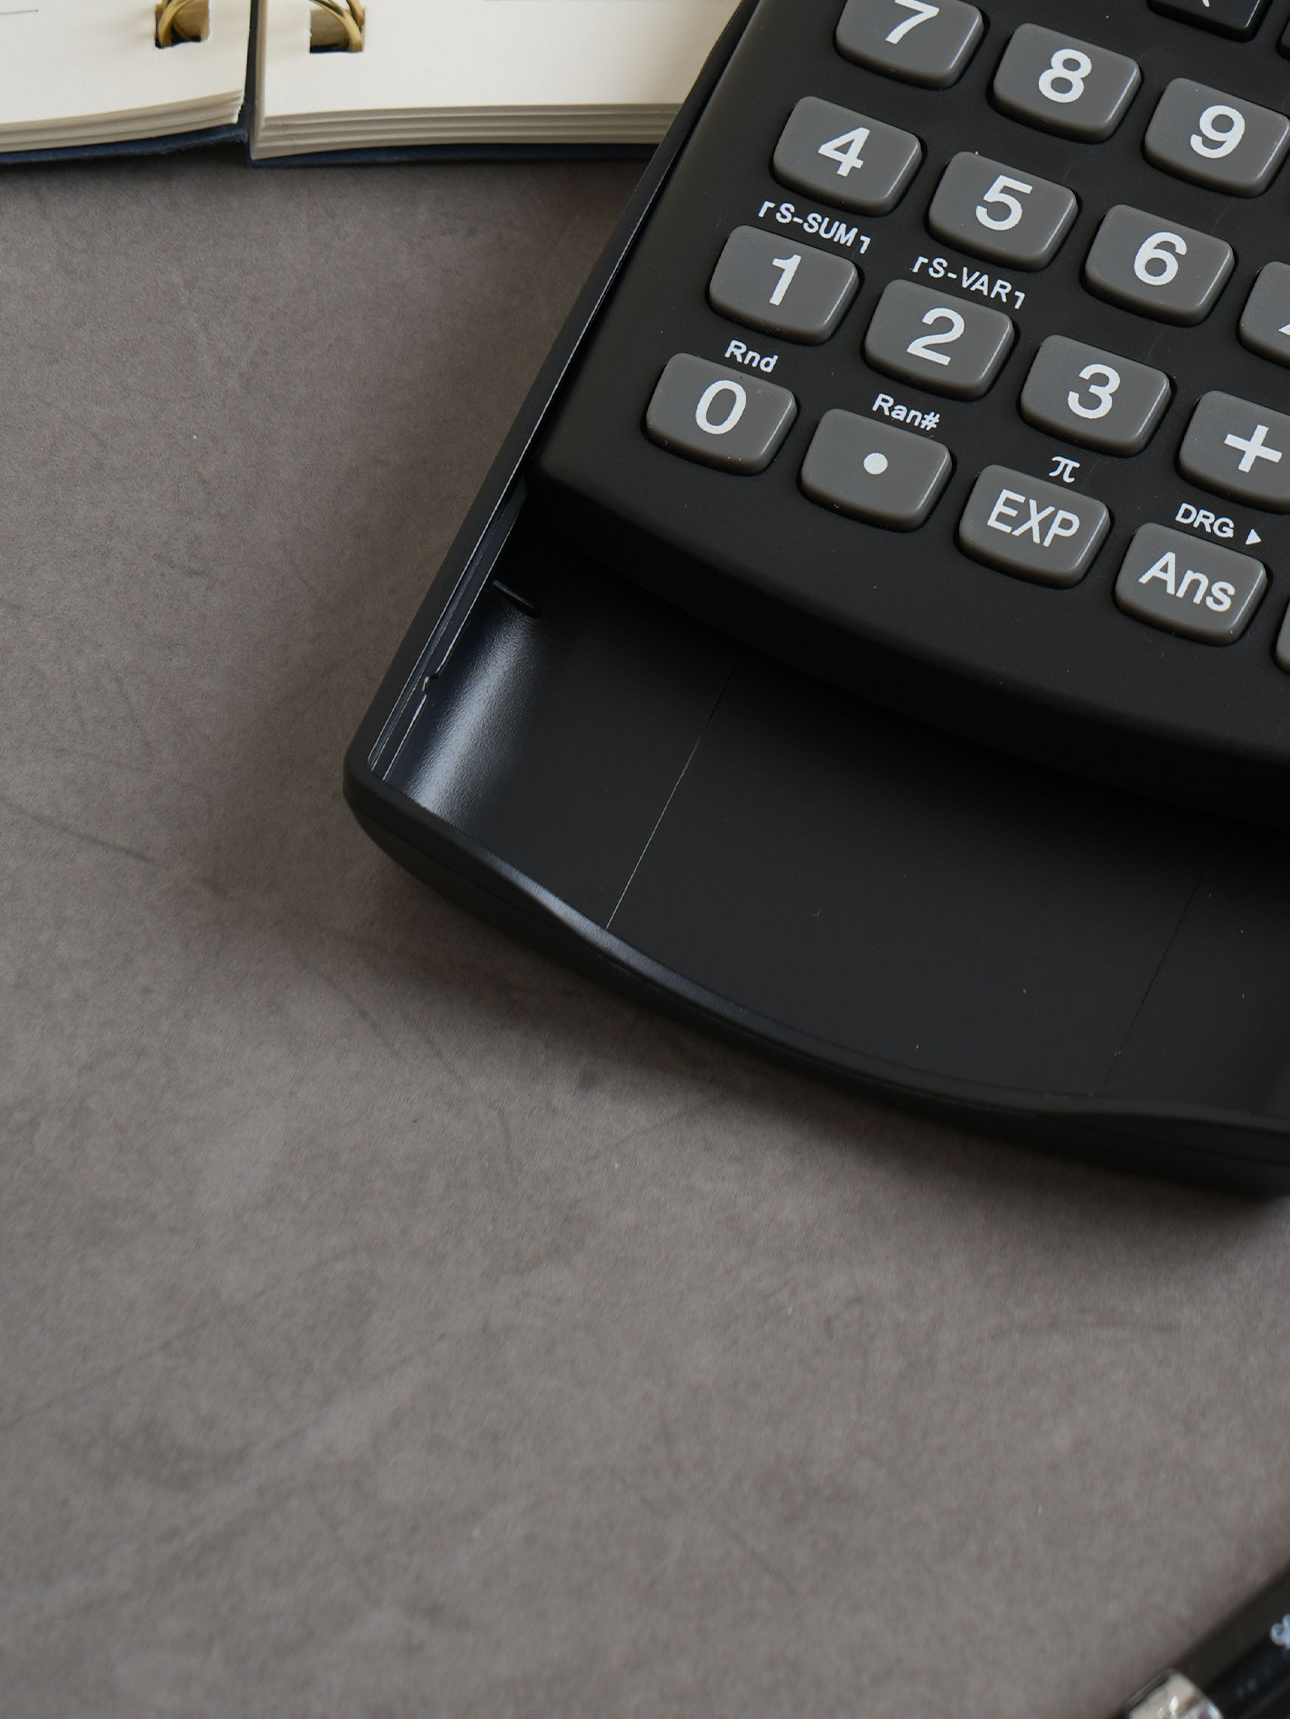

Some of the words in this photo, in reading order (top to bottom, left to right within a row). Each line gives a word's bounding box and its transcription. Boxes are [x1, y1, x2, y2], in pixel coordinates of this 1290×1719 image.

[1038, 48, 1093, 103] 8
[817, 127, 871, 177] 4
[1190, 105, 1246, 159] 9
[975, 174, 1033, 231] 5
[769, 254, 802, 306] 1
[1133, 231, 1188, 286] 6
[724, 339, 779, 373] Rnd
[906, 307, 965, 366] 2
[695, 379, 747, 435] 0
[872, 393, 941, 431] Ran#
[1067, 363, 1121, 420] 3
[1048, 456, 1081, 483] π
[986, 489, 1080, 548] EXP
[1175, 502, 1235, 538] DRG
[1138, 551, 1236, 612] Ans
